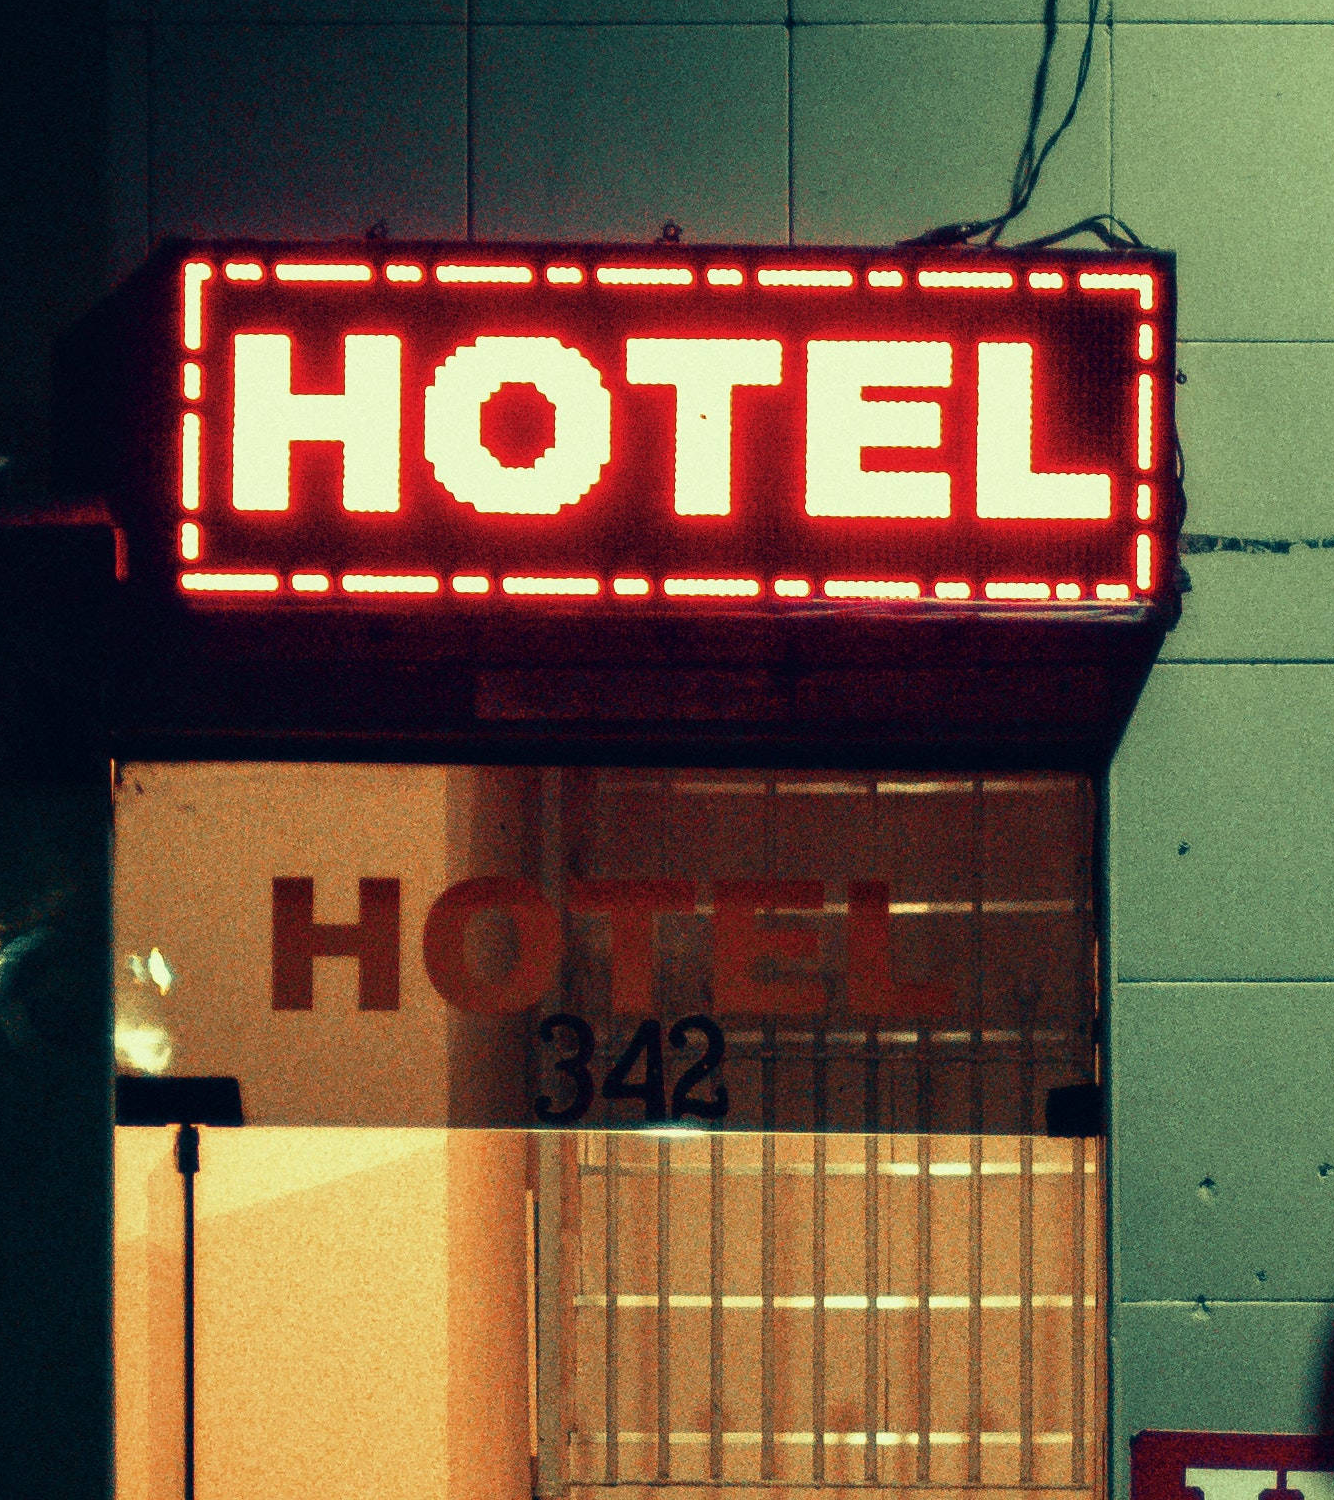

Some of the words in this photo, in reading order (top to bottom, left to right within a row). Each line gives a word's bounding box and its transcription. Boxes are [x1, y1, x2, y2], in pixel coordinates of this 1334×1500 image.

[231, 332, 1112, 520] HOTEL
[271, 876, 957, 1017] HOTEL
[532, 1013, 730, 1126] 342
